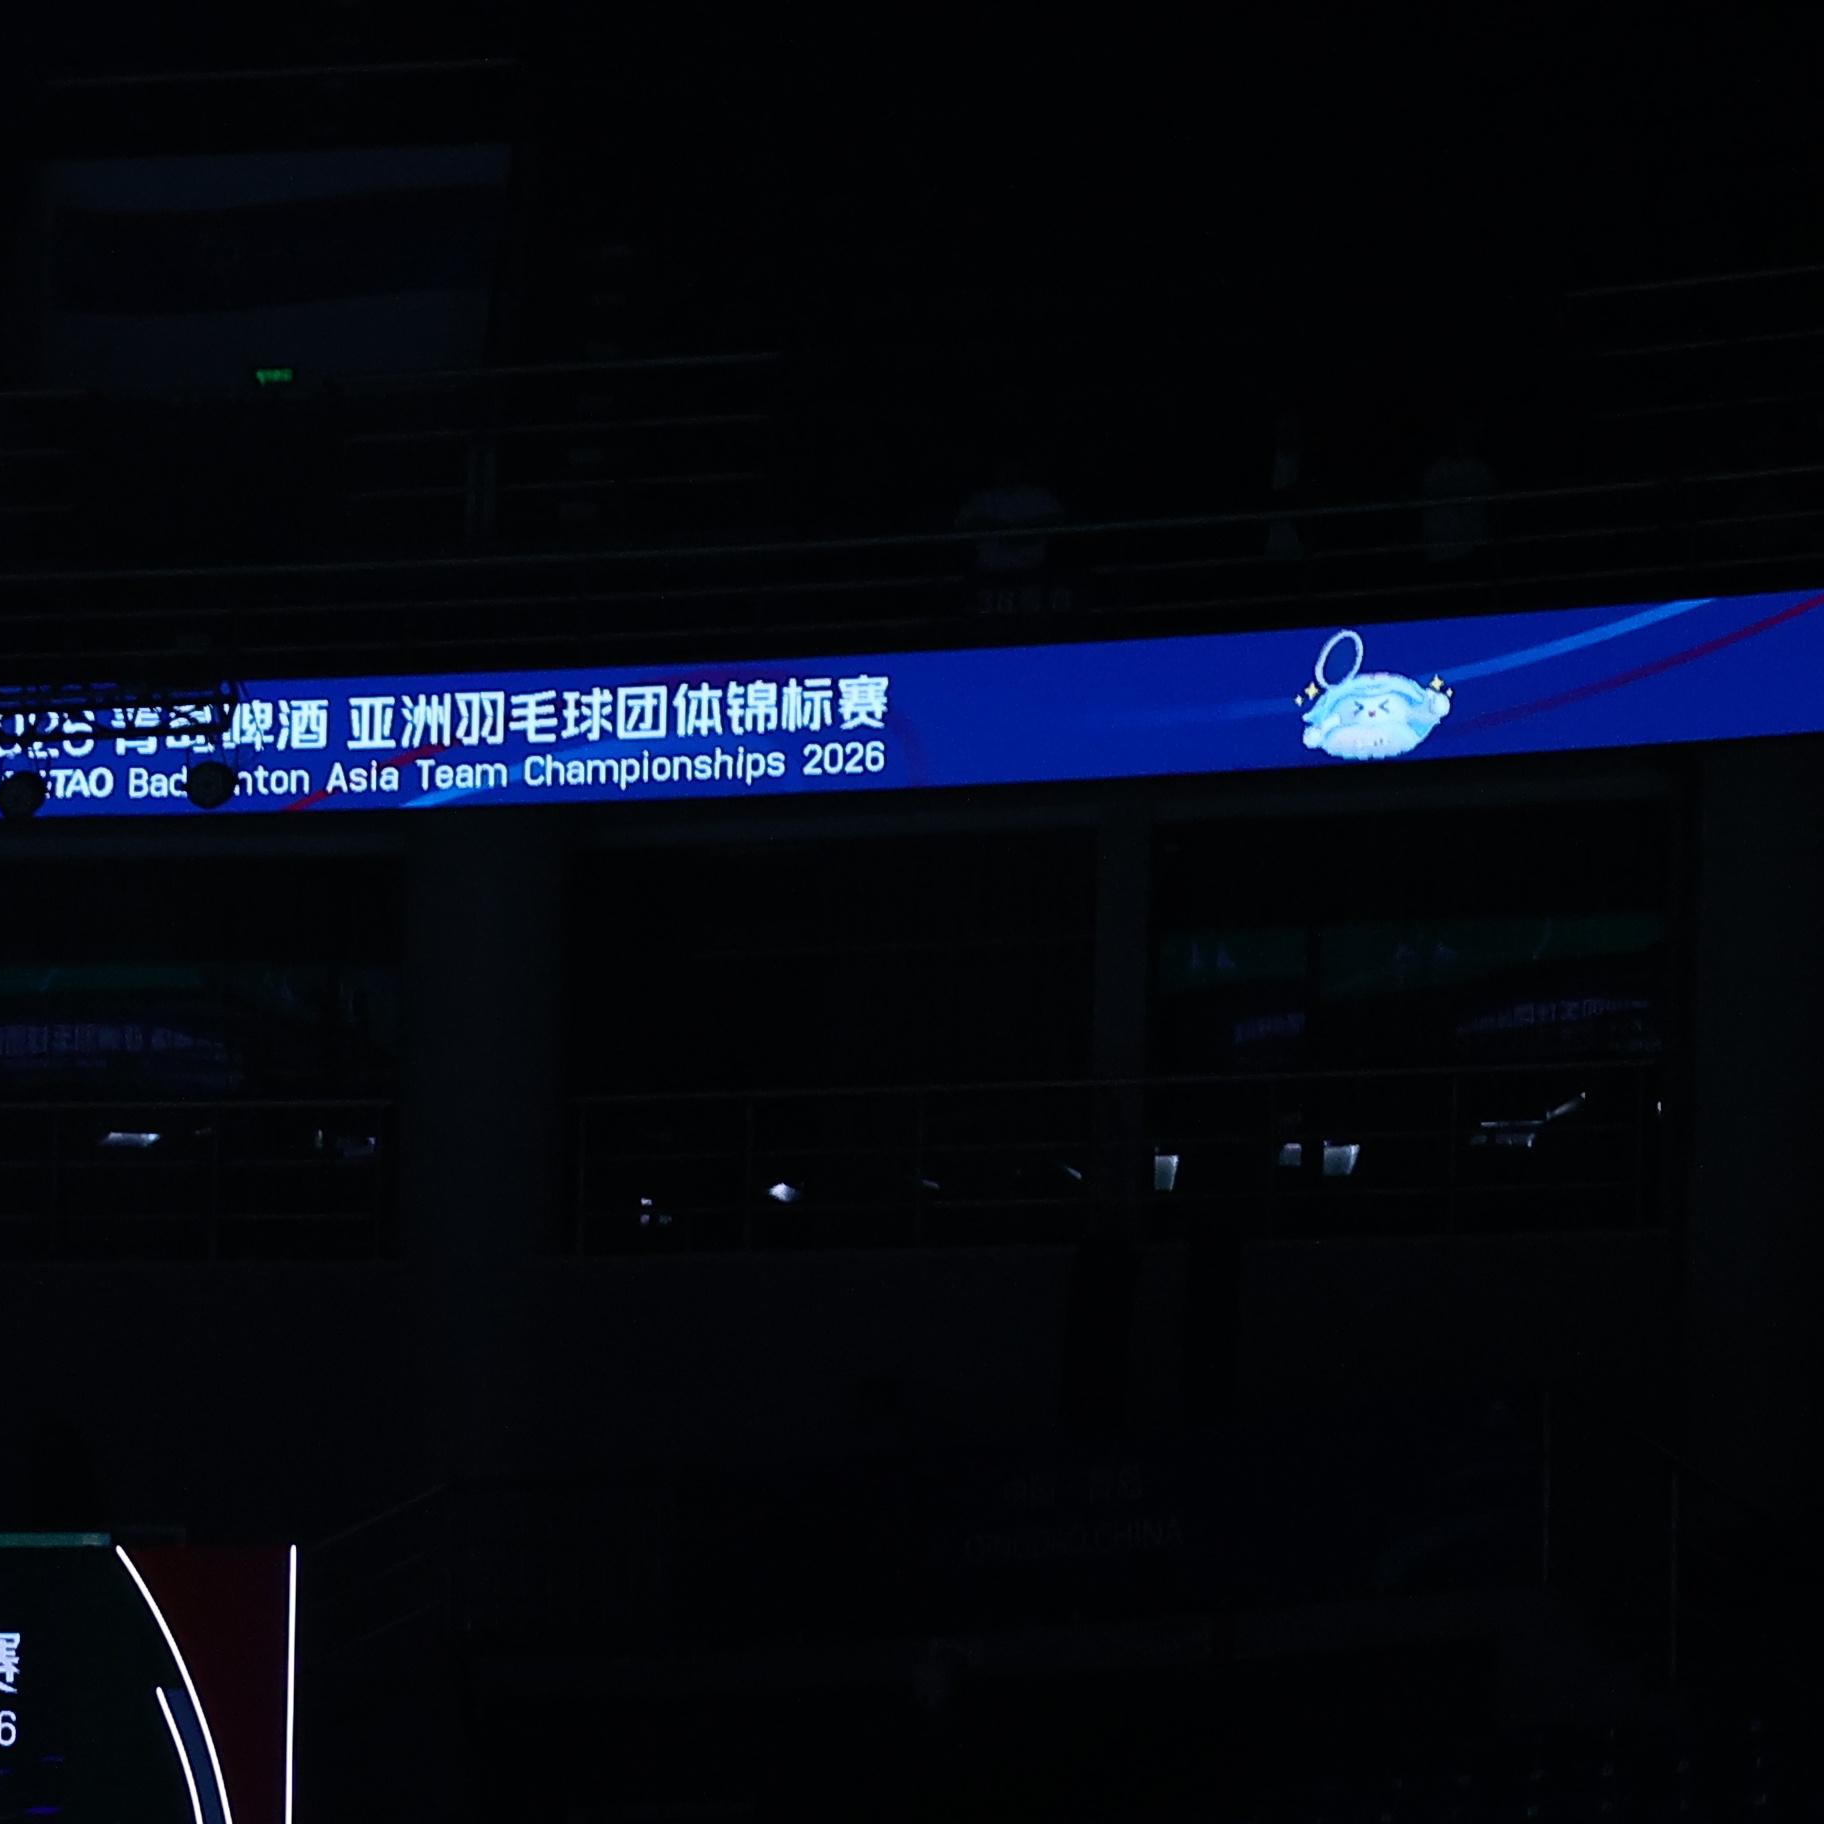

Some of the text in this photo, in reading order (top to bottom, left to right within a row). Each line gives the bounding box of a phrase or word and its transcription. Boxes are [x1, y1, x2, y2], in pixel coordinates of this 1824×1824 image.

[347, 676, 889, 751] 亚洲羽毛球团体锦标赛
[128, 765, 310, 799] Badnton
[327, 759, 400, 795] Asia
[417, 757, 509, 791] Team
[523, 747, 786, 793] Championships
[803, 741, 886, 776] 2026
